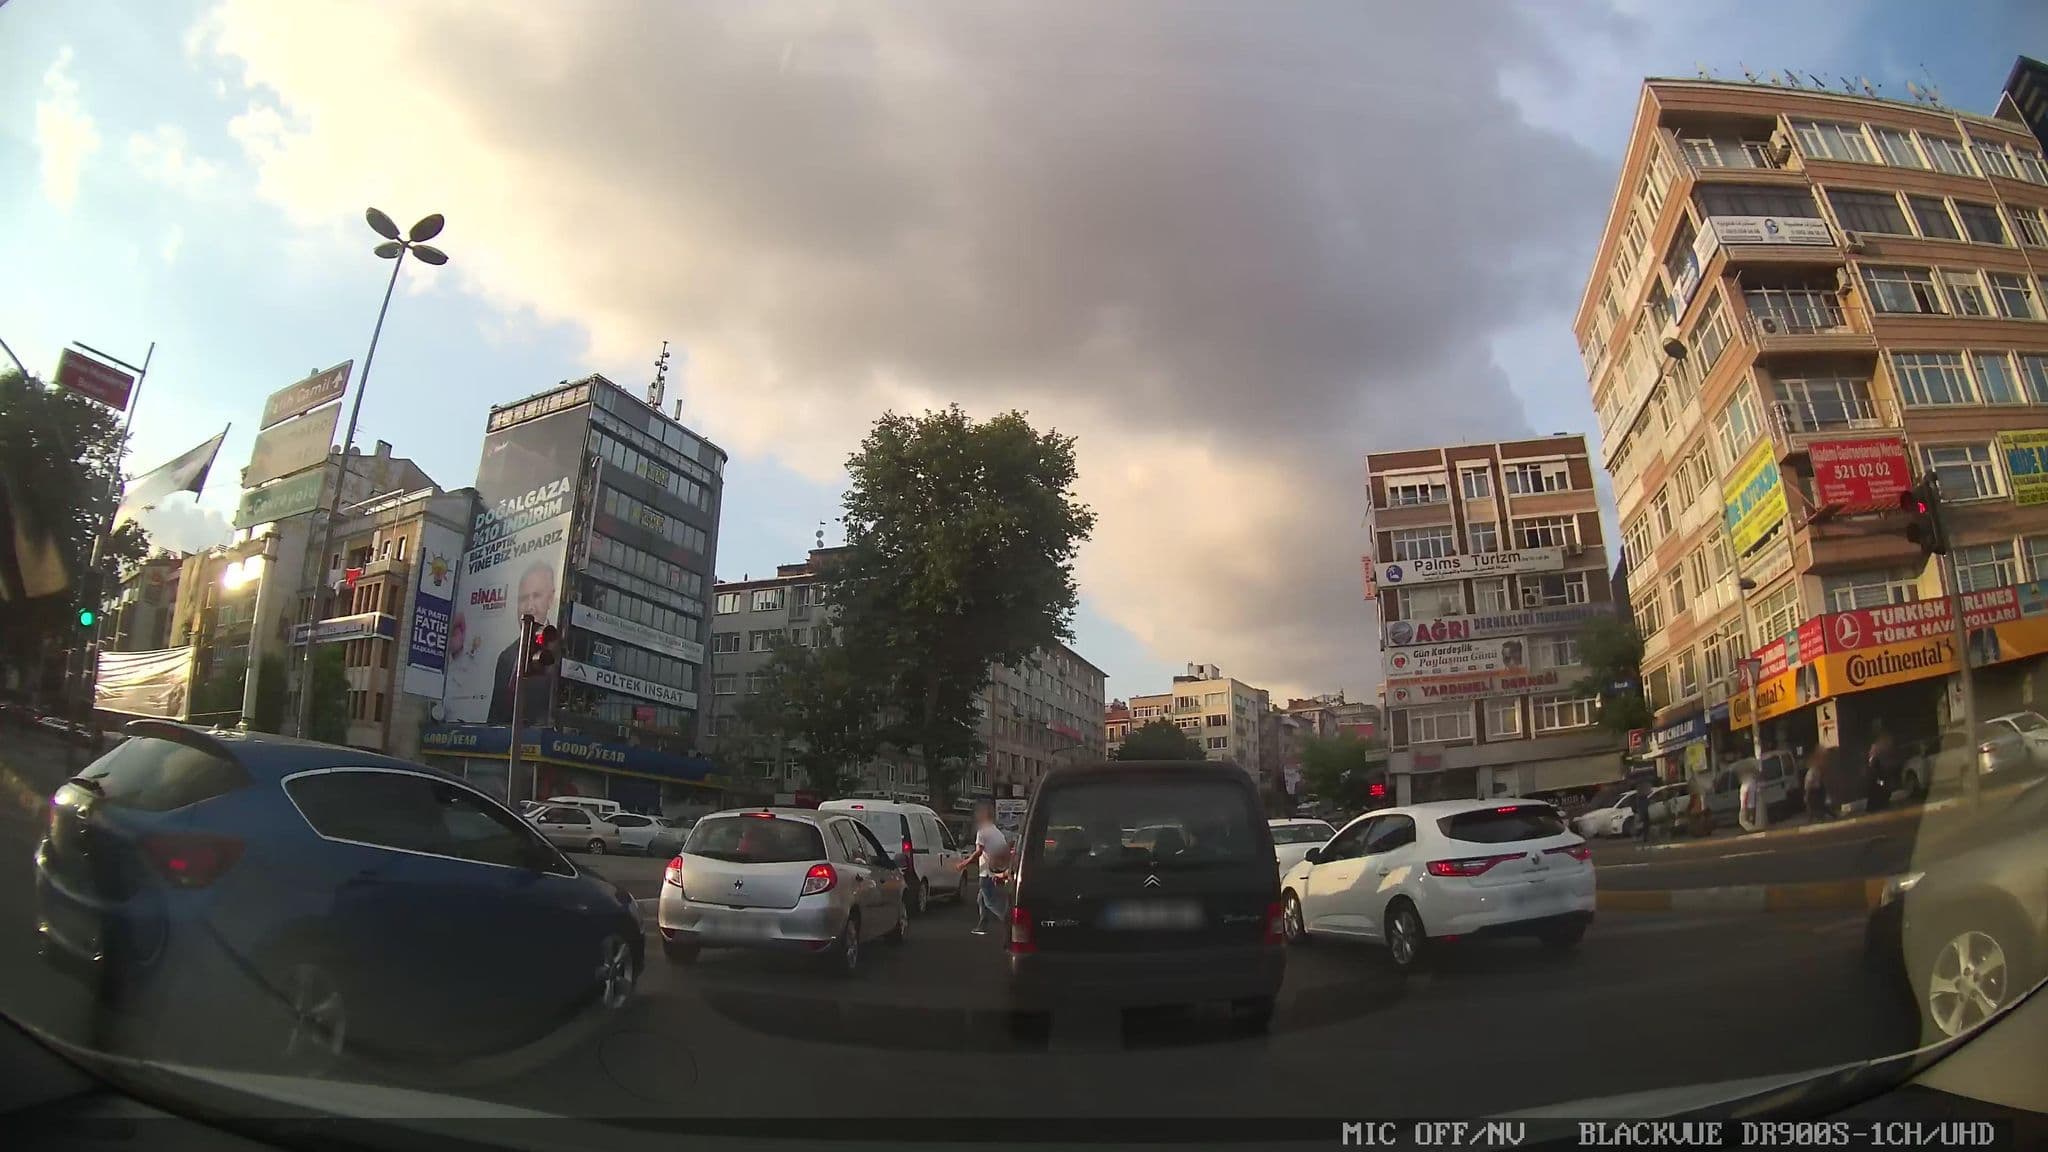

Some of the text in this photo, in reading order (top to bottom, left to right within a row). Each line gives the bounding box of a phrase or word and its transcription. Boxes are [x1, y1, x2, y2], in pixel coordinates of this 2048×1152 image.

[1834, 464, 1857, 479] 521
[1859, 463, 1874, 477] 02
[1875, 461, 1891, 475] 02
[474, 476, 571, 530] DOĞALGAZA
[473, 497, 563, 548] %10 İNDİRİM
[468, 529, 564, 575] YİNE BİZ YAPARIZ
[484, 535, 518, 556] YAPTIK
[1414, 557, 1461, 572] Palms
[1470, 551, 1521, 566] Turizm
[470, 583, 509, 605] BİNALİ
[416, 606, 428, 615] AK
[1869, 600, 1945, 626] TURKISH
[415, 614, 448, 634] FATİH
[1415, 618, 1470, 643] AĞRI
[413, 627, 447, 650] İLÇE
[1872, 626, 1918, 645] TÜRK
[1431, 643, 1473, 658] Kardeşlik
[1845, 641, 1944, 687] Continental
[596, 671, 641, 692] POLTEK
[1658, 720, 1694, 744] MICHELIN
[552, 739, 626, 763] GOODYEAR
